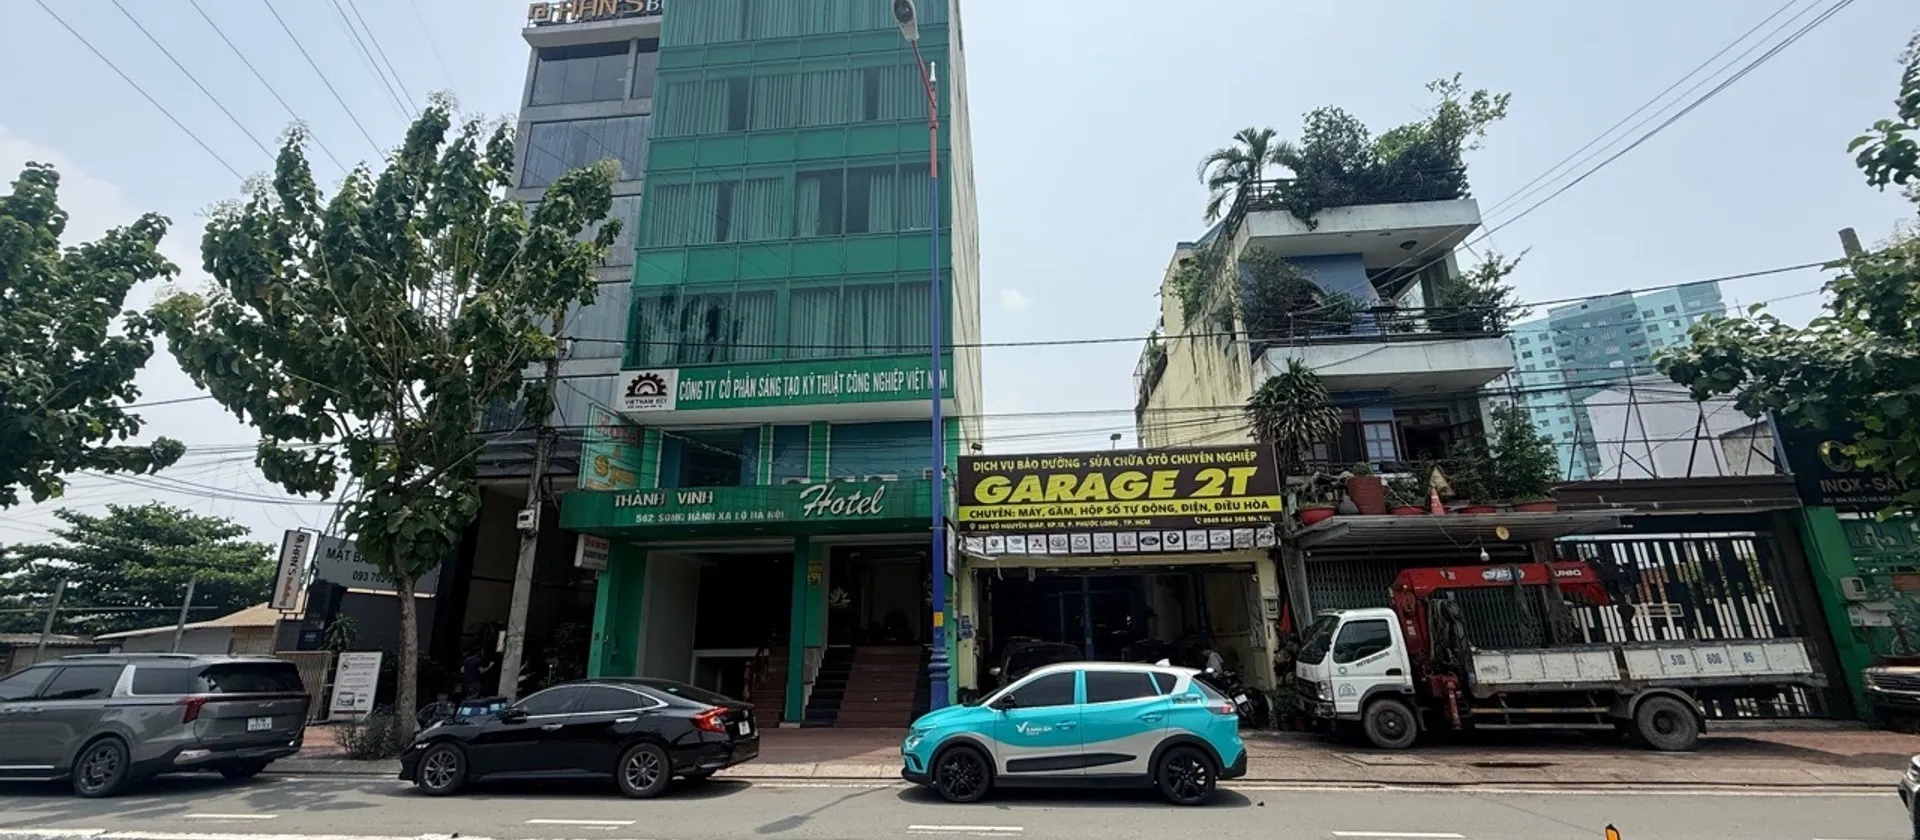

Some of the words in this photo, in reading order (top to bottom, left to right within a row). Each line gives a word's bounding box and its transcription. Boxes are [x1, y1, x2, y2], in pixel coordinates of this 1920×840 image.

[679, 377, 703, 401] CÔNG
[705, 380, 717, 400] TY
[718, 370, 731, 399] CỔ
[733, 373, 756, 399] PHẦN
[758, 373, 782, 397] SÁNG
[783, 375, 800, 399] TẠO
[817, 371, 845, 397] THUẬT
[846, 369, 870, 393] CÔNG
[873, 368, 905, 394] NGHIỆP
[905, 367, 925, 394] VIỆT
[927, 369, 948, 389] NM
[973, 461, 998, 473] DỊCH
[1000, 460, 1014, 472] VỤ
[1017, 457, 1039, 469] BẢO
[1089, 455, 1112, 468] SỬA
[1113, 454, 1144, 467] CHỮA
[1146, 453, 1168, 465] ÔTÔ
[1170, 450, 1214, 465] CHUYÊN
[1215, 449, 1257, 464] NGHIỆP
[974, 469, 1180, 504] GARAGE
[1188, 466, 1258, 498] 2T
[1819, 478, 1863, 493] INOX
[614, 489, 665, 507] THÀNH
[677, 490, 713, 505] VINH
[799, 484, 885, 517] Hotel
[969, 507, 1016, 519] CHUYÊN:
[1080, 505, 1104, 517] HỘP
[1106, 502, 1120, 514] SỐ
[1124, 503, 1140, 515] TỰ
[1214, 499, 1241, 511] ĐIỀU
[1243, 499, 1270, 510] HÒA
[718, 511, 732, 520] XA
